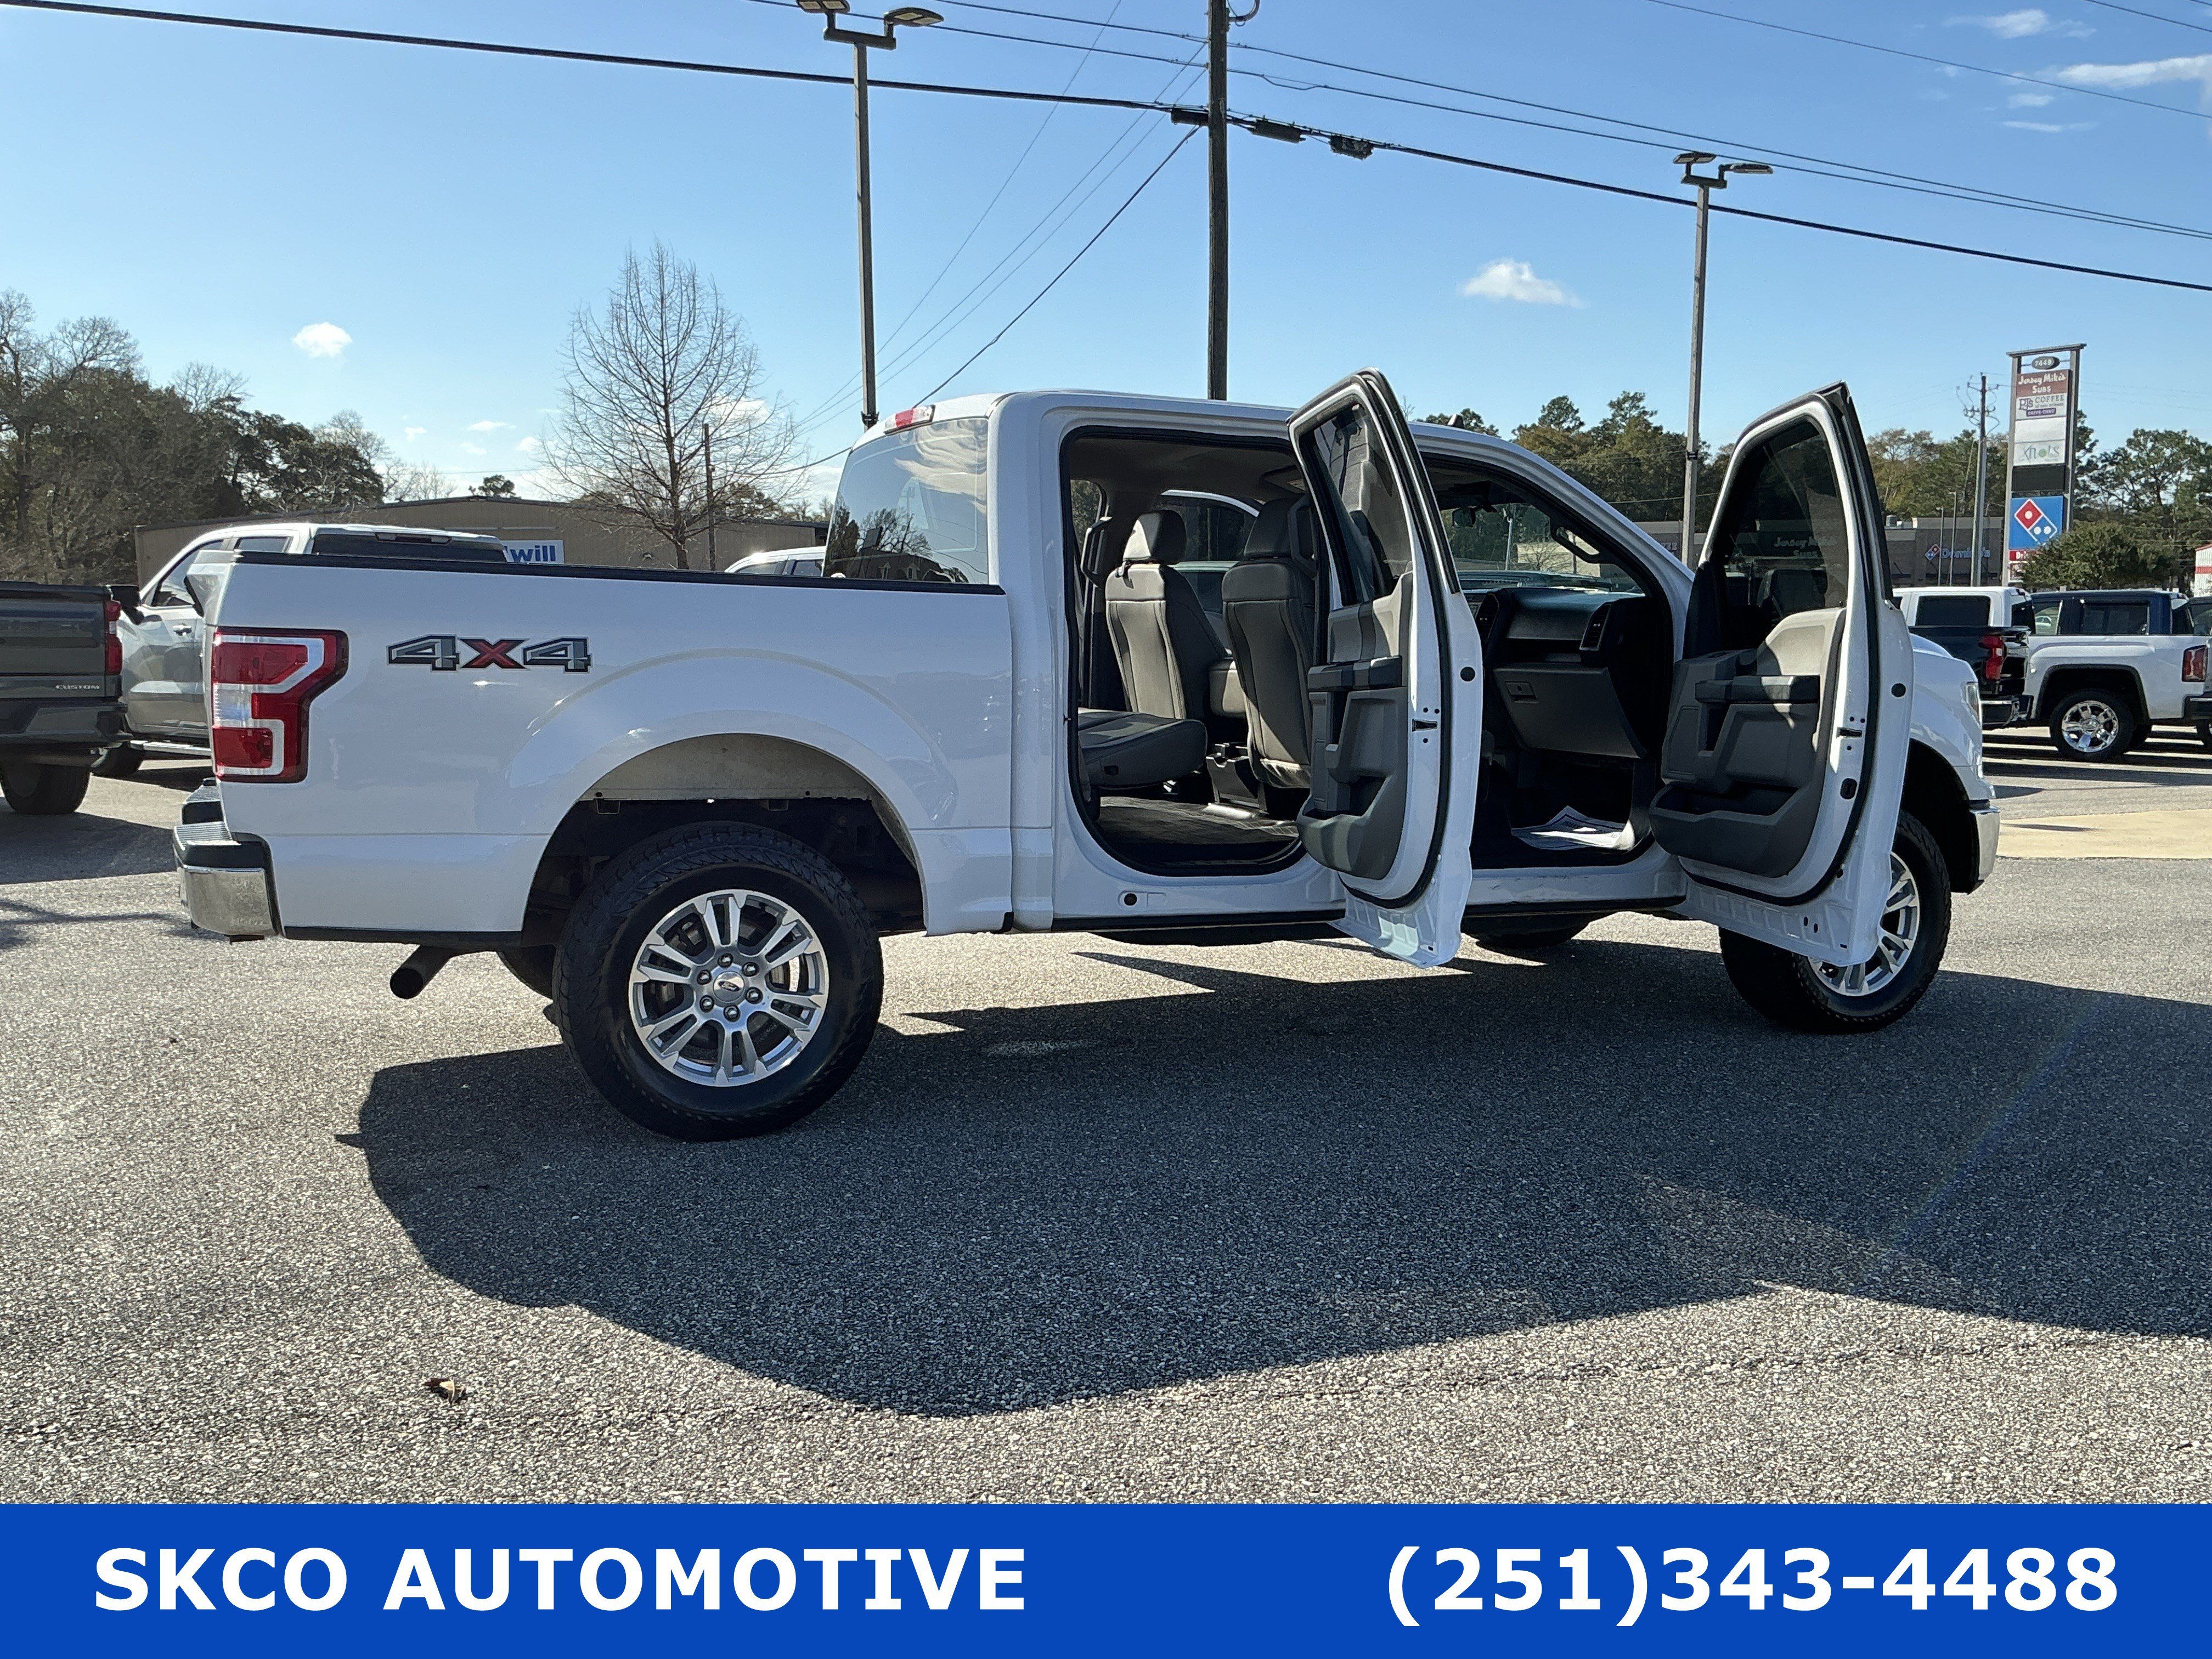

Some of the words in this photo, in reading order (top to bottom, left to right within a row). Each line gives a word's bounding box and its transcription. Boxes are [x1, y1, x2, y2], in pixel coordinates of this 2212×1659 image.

[2018, 376, 2042, 385] Jersey
[2043, 373, 2066, 382] Mike's
[2035, 395, 2064, 403] COFFEE
[504, 545, 556, 563] will
